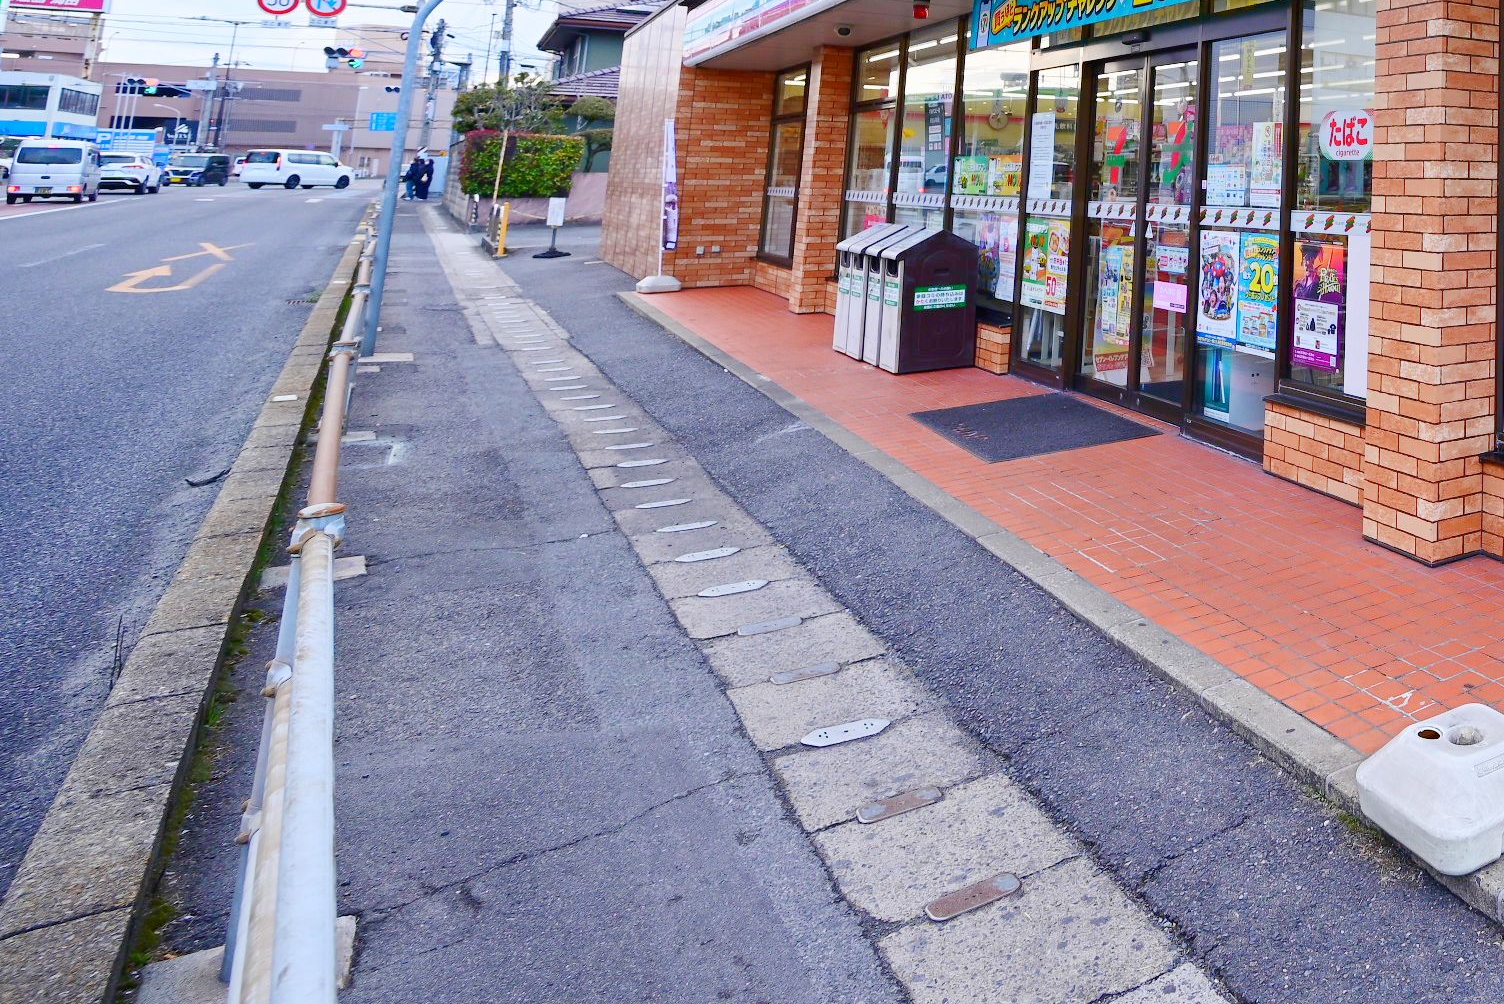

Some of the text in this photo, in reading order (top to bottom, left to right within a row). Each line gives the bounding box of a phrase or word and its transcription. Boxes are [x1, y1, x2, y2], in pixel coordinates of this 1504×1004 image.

[96, 132, 111, 143] P
[1329, 116, 1368, 147] たばこ
[1335, 149, 1360, 157] cigarette
[1046, 276, 1057, 296] 50
[1249, 261, 1275, 295] 20
